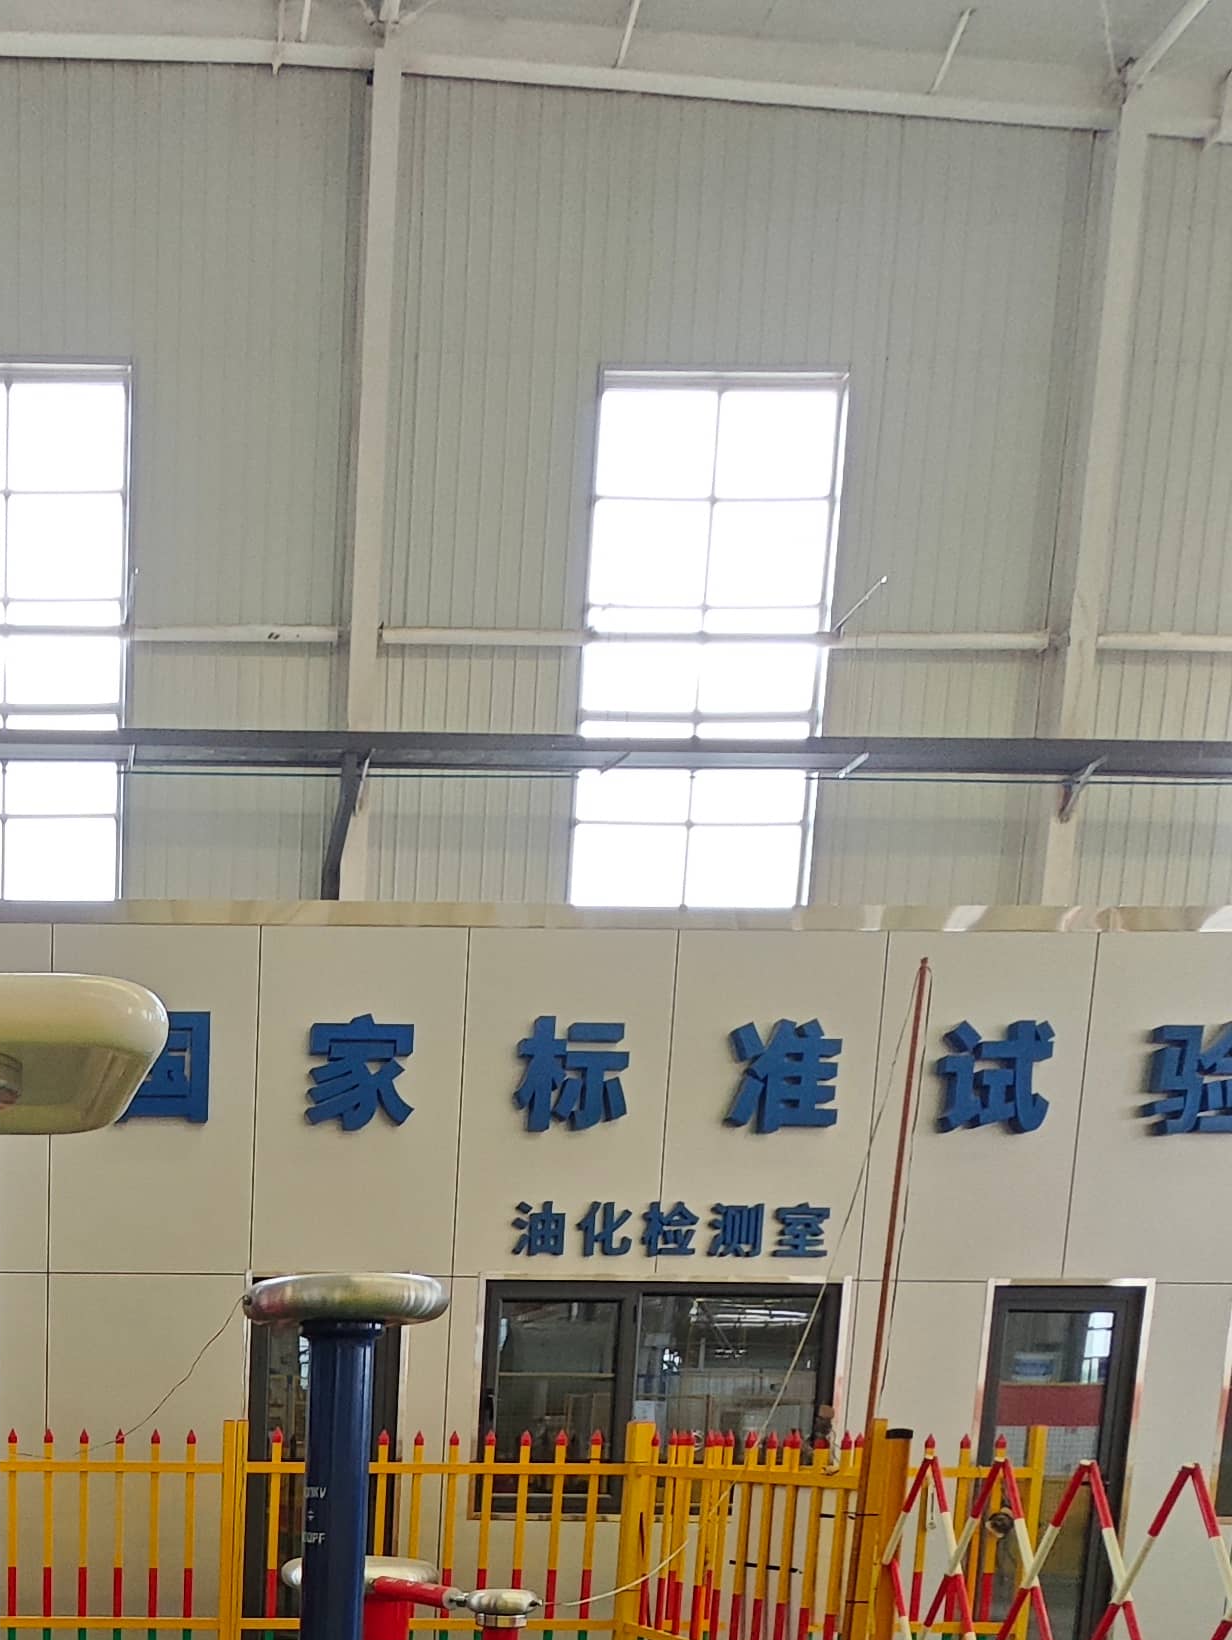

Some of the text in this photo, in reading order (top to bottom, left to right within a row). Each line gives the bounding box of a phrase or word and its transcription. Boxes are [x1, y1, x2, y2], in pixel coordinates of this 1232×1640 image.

[511, 1201, 831, 1257] 油化检测室
